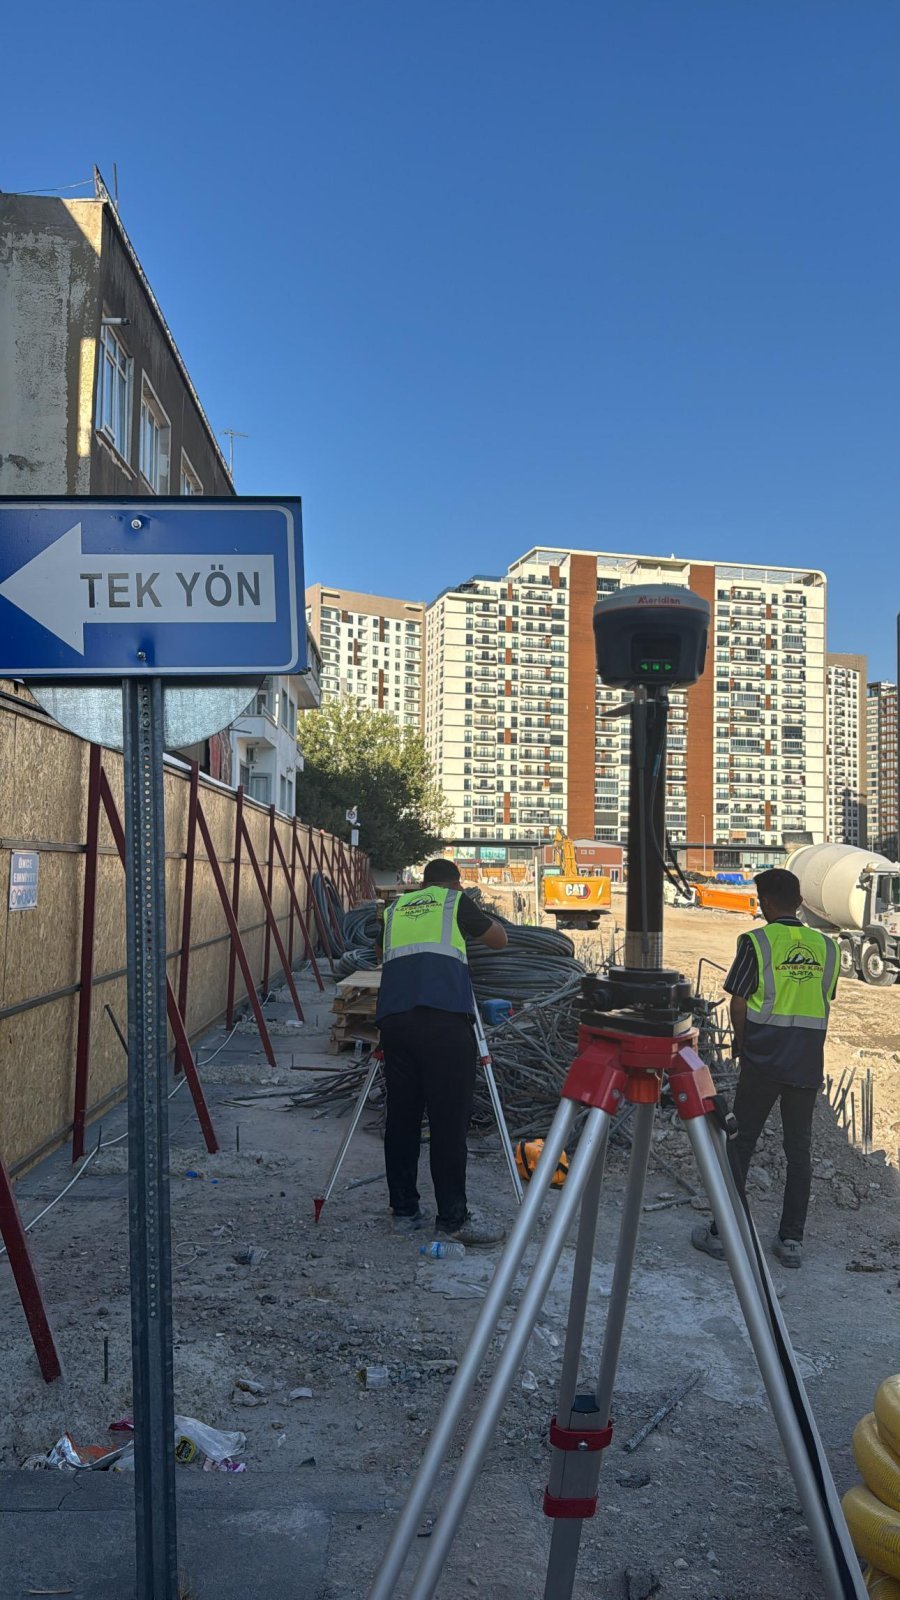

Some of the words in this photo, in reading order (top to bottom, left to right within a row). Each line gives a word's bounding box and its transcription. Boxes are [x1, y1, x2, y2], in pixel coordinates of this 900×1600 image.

[80, 573, 162, 608] TEK
[176, 564, 261, 607] YÖN
[565, 883, 585, 896] CAT
